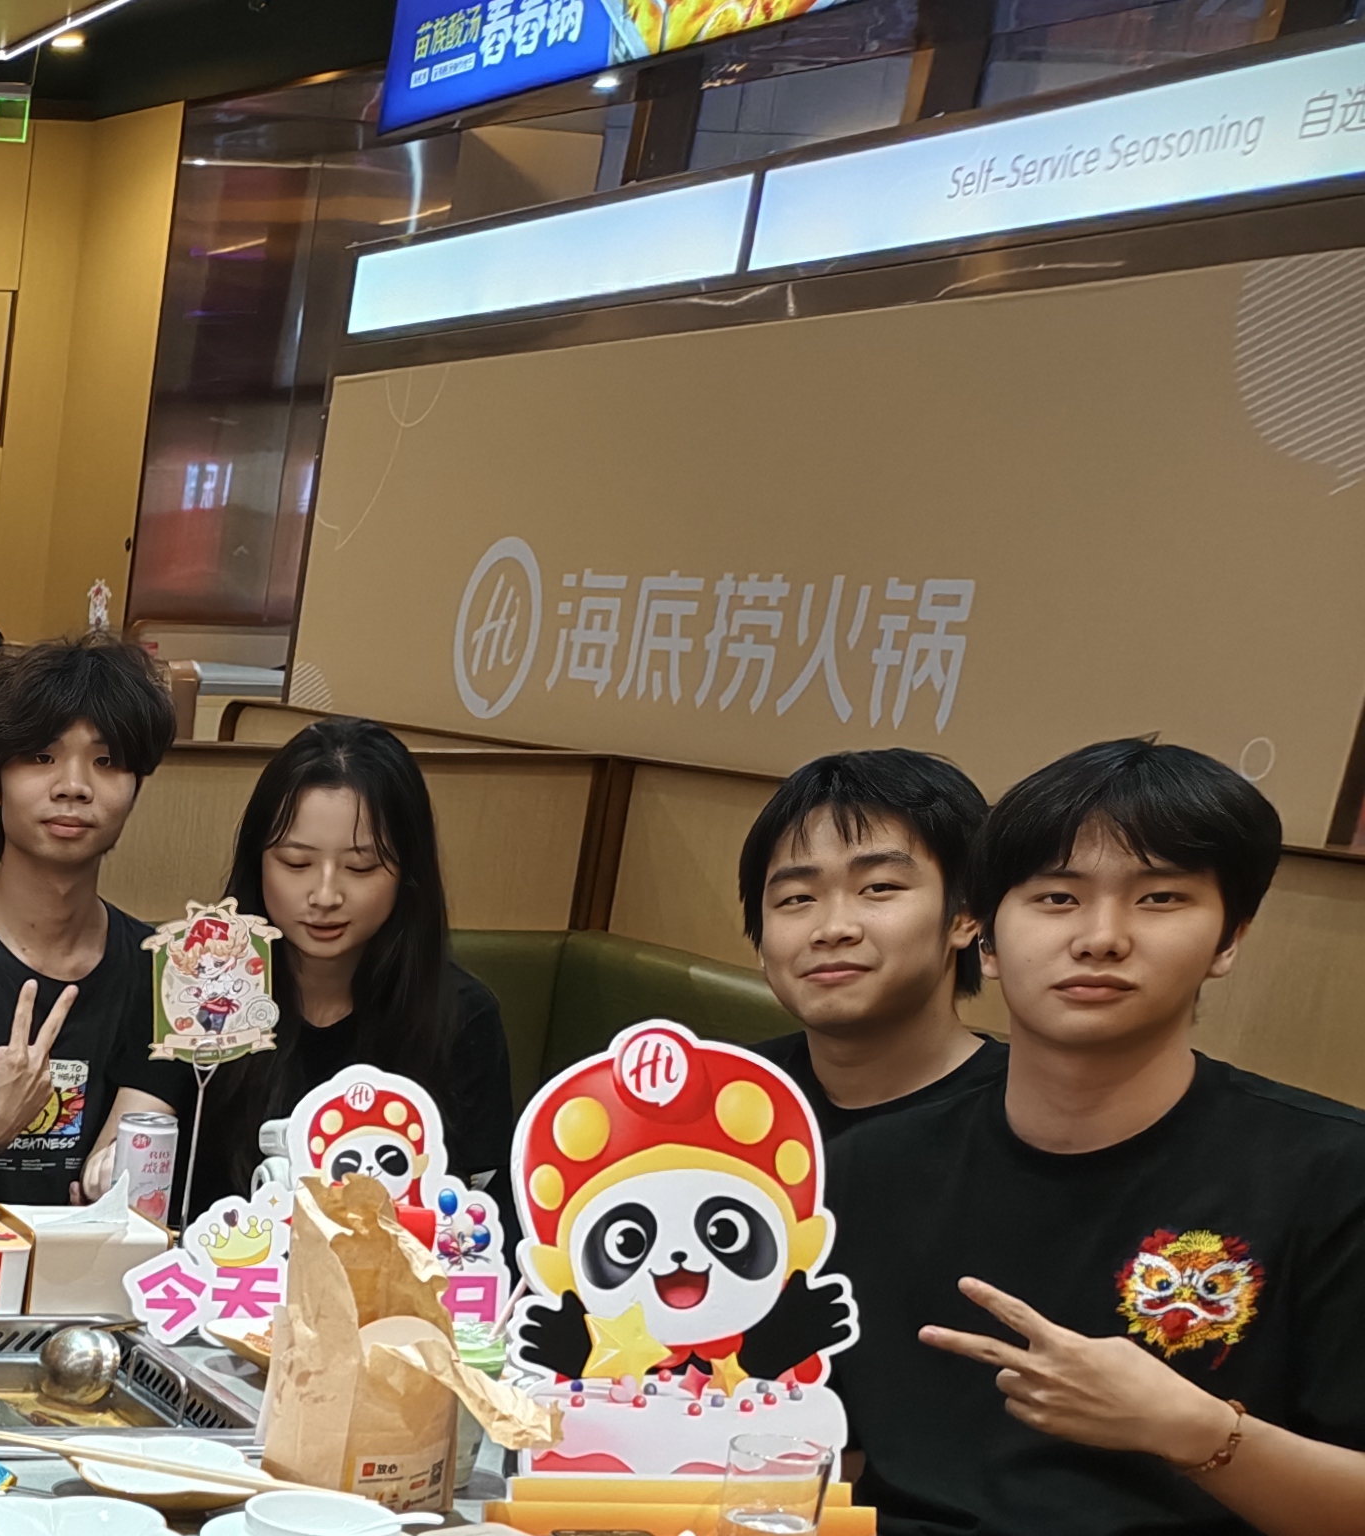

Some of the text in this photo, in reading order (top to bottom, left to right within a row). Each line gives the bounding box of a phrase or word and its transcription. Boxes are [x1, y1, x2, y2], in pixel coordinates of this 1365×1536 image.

[946, 113, 1266, 199] Self-Service Seasoning
[545, 568, 976, 735] 海底捞火锅
[70, 1062, 83, 1073] TO
[627, 1038, 679, 1094] Hi
